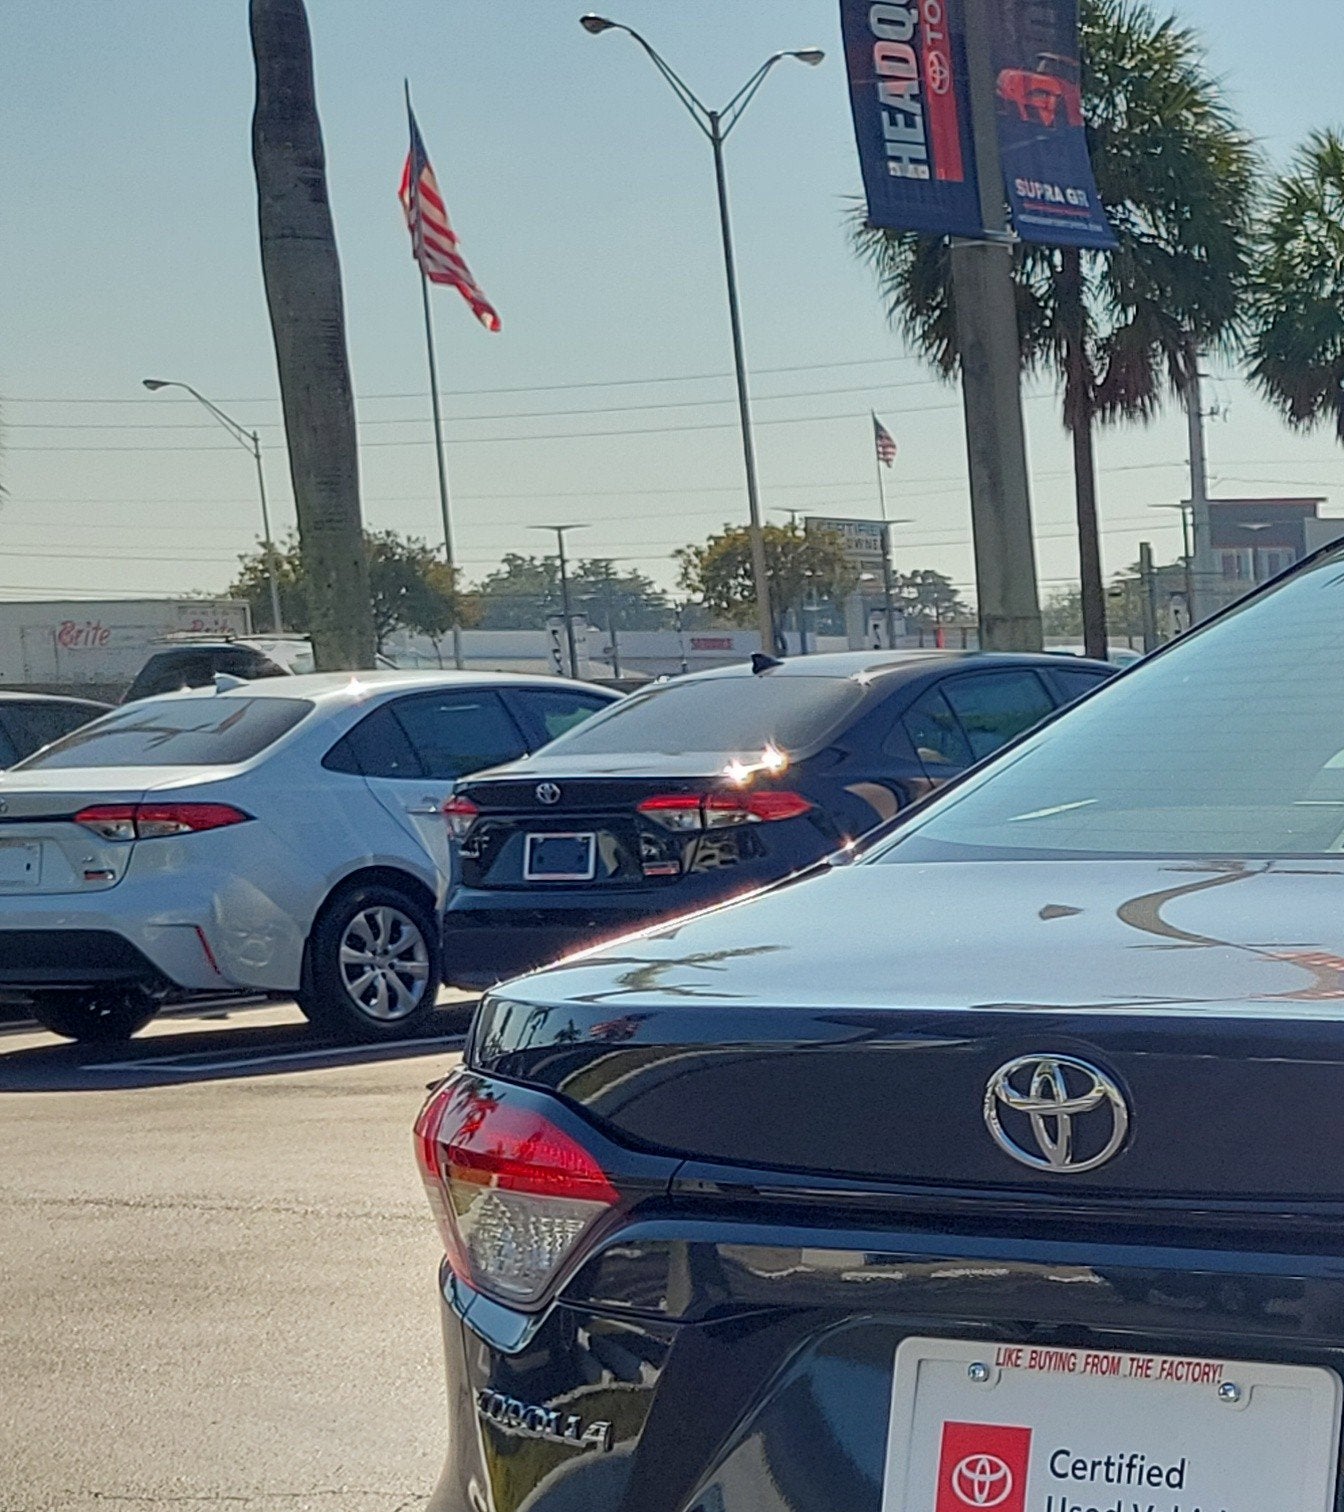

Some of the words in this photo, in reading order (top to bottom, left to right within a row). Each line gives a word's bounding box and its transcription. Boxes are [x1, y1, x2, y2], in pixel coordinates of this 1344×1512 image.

[869, 0, 930, 180] HEADQ
[1015, 178, 1066, 204] SUPRA
[995, 1347, 1024, 1368] LIKE
[1028, 1350, 1077, 1373] BUYING
[1084, 1354, 1122, 1376] FROM
[1129, 1357, 1153, 1379] THE
[1160, 1360, 1224, 1384] FACTORY!
[1049, 1448, 1187, 1490] Certified
